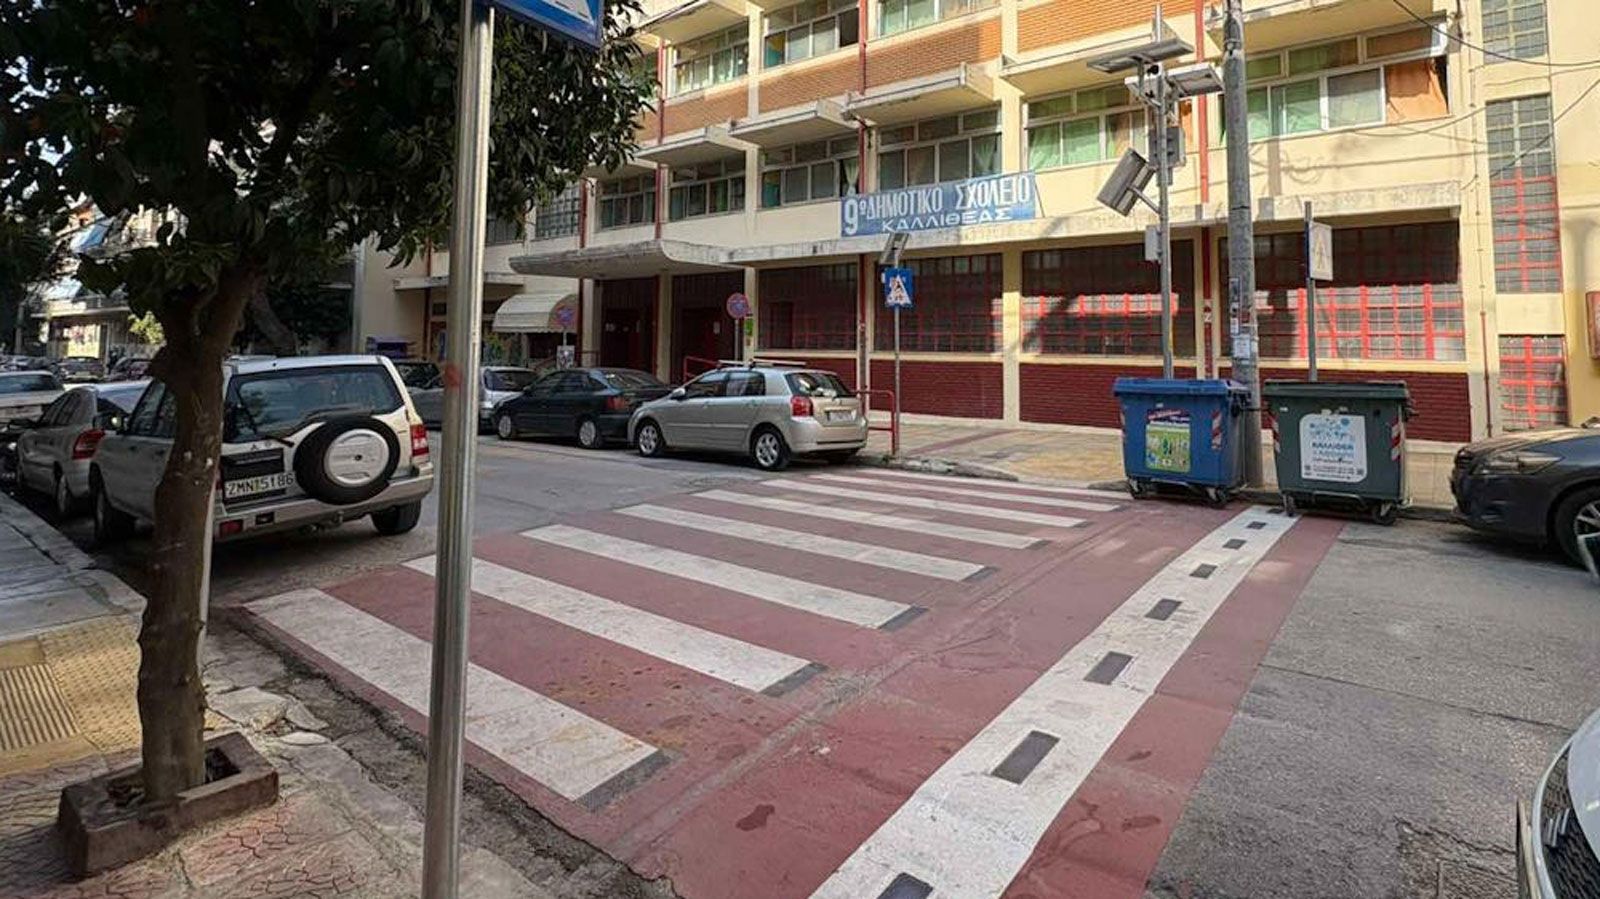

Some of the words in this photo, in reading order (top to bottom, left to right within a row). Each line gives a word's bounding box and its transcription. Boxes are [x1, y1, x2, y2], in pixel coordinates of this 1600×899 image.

[866, 187, 943, 220] ΔΗΜΟΤΙΚΟ
[955, 175, 1031, 210] ΣΧΟΛΕΙΟ
[882, 208, 1011, 233] ΚΑΛΛΙΘΕΑΣ
